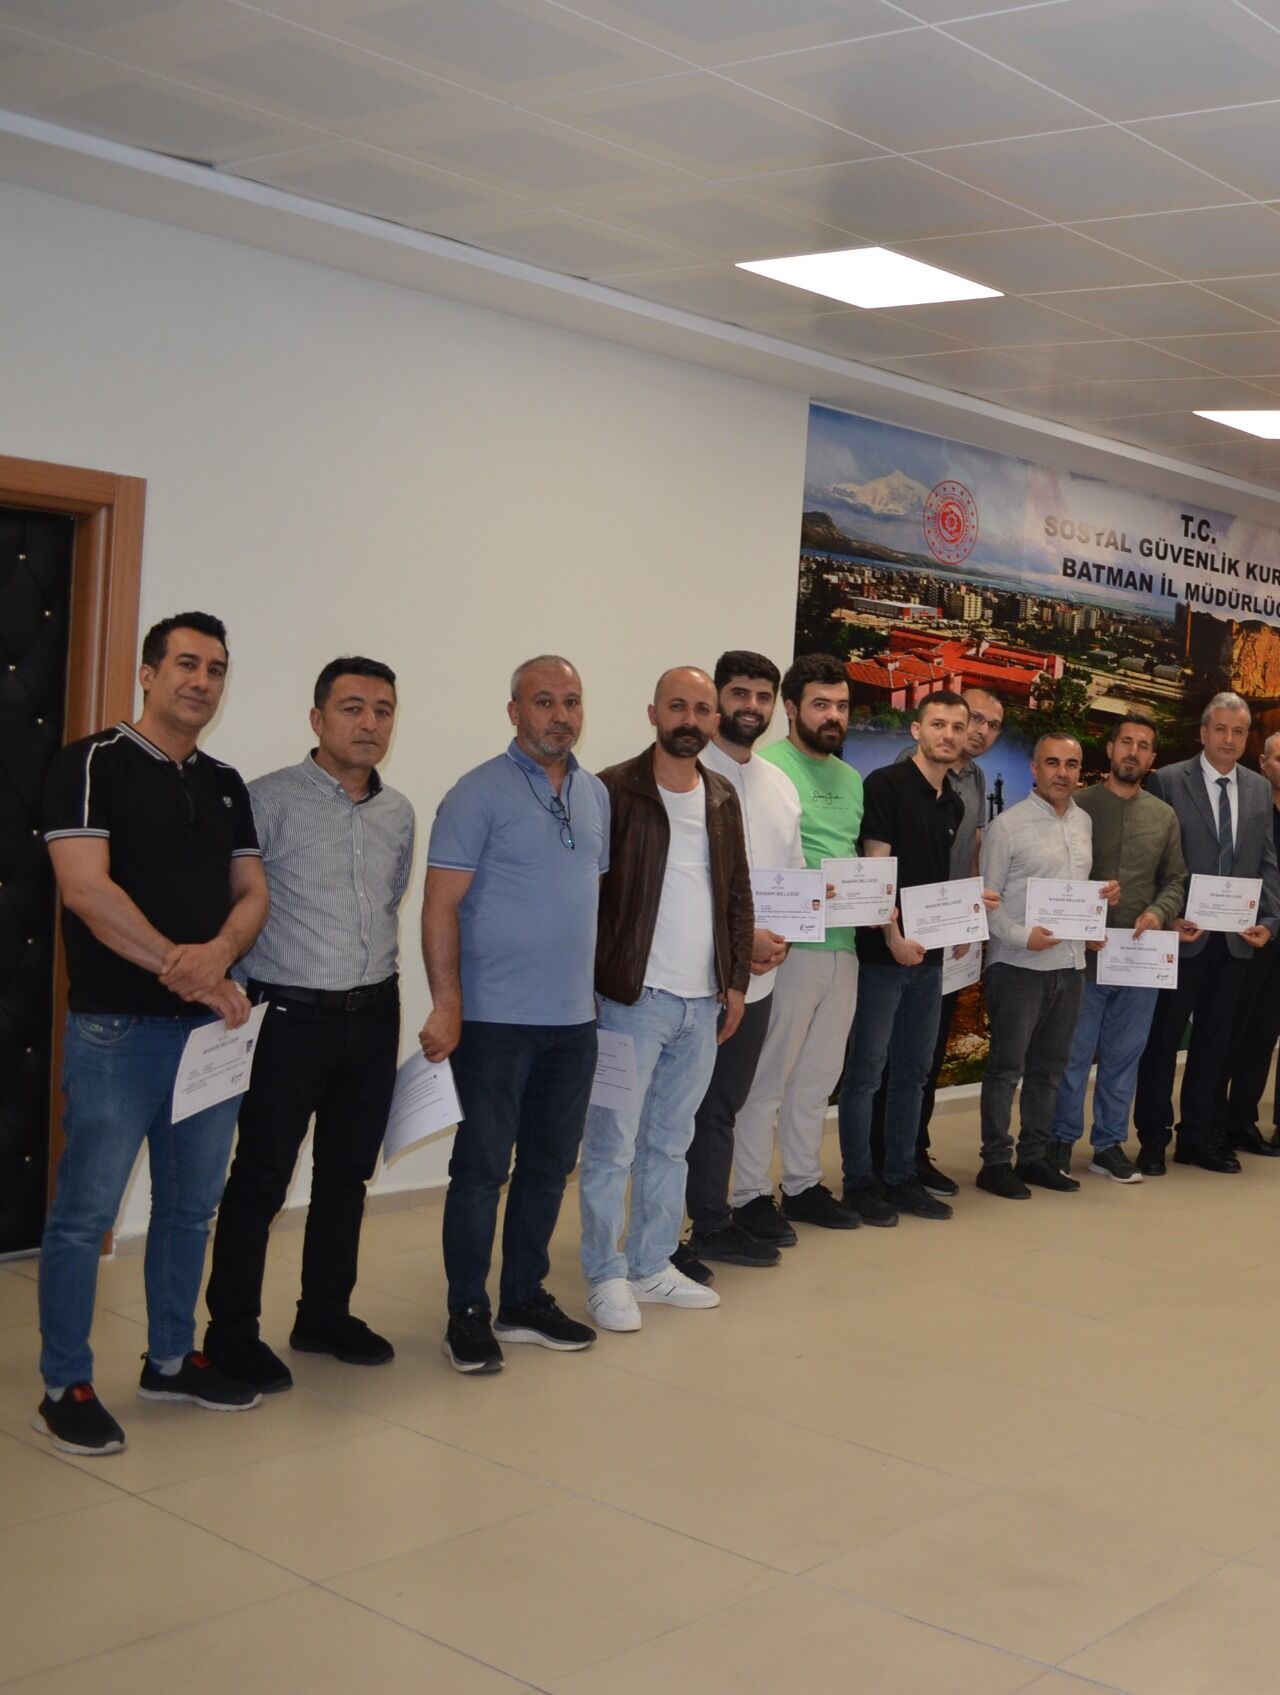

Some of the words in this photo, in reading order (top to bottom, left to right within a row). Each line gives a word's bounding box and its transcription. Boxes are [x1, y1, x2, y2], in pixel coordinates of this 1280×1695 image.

[1044, 515, 1131, 553] SOSYAL
[1139, 537, 1240, 577] GÜVENLİK
[1180, 513, 1216, 544] T.C.
[1062, 557, 1153, 593] BATMAN
[1160, 572, 1178, 598] İL
